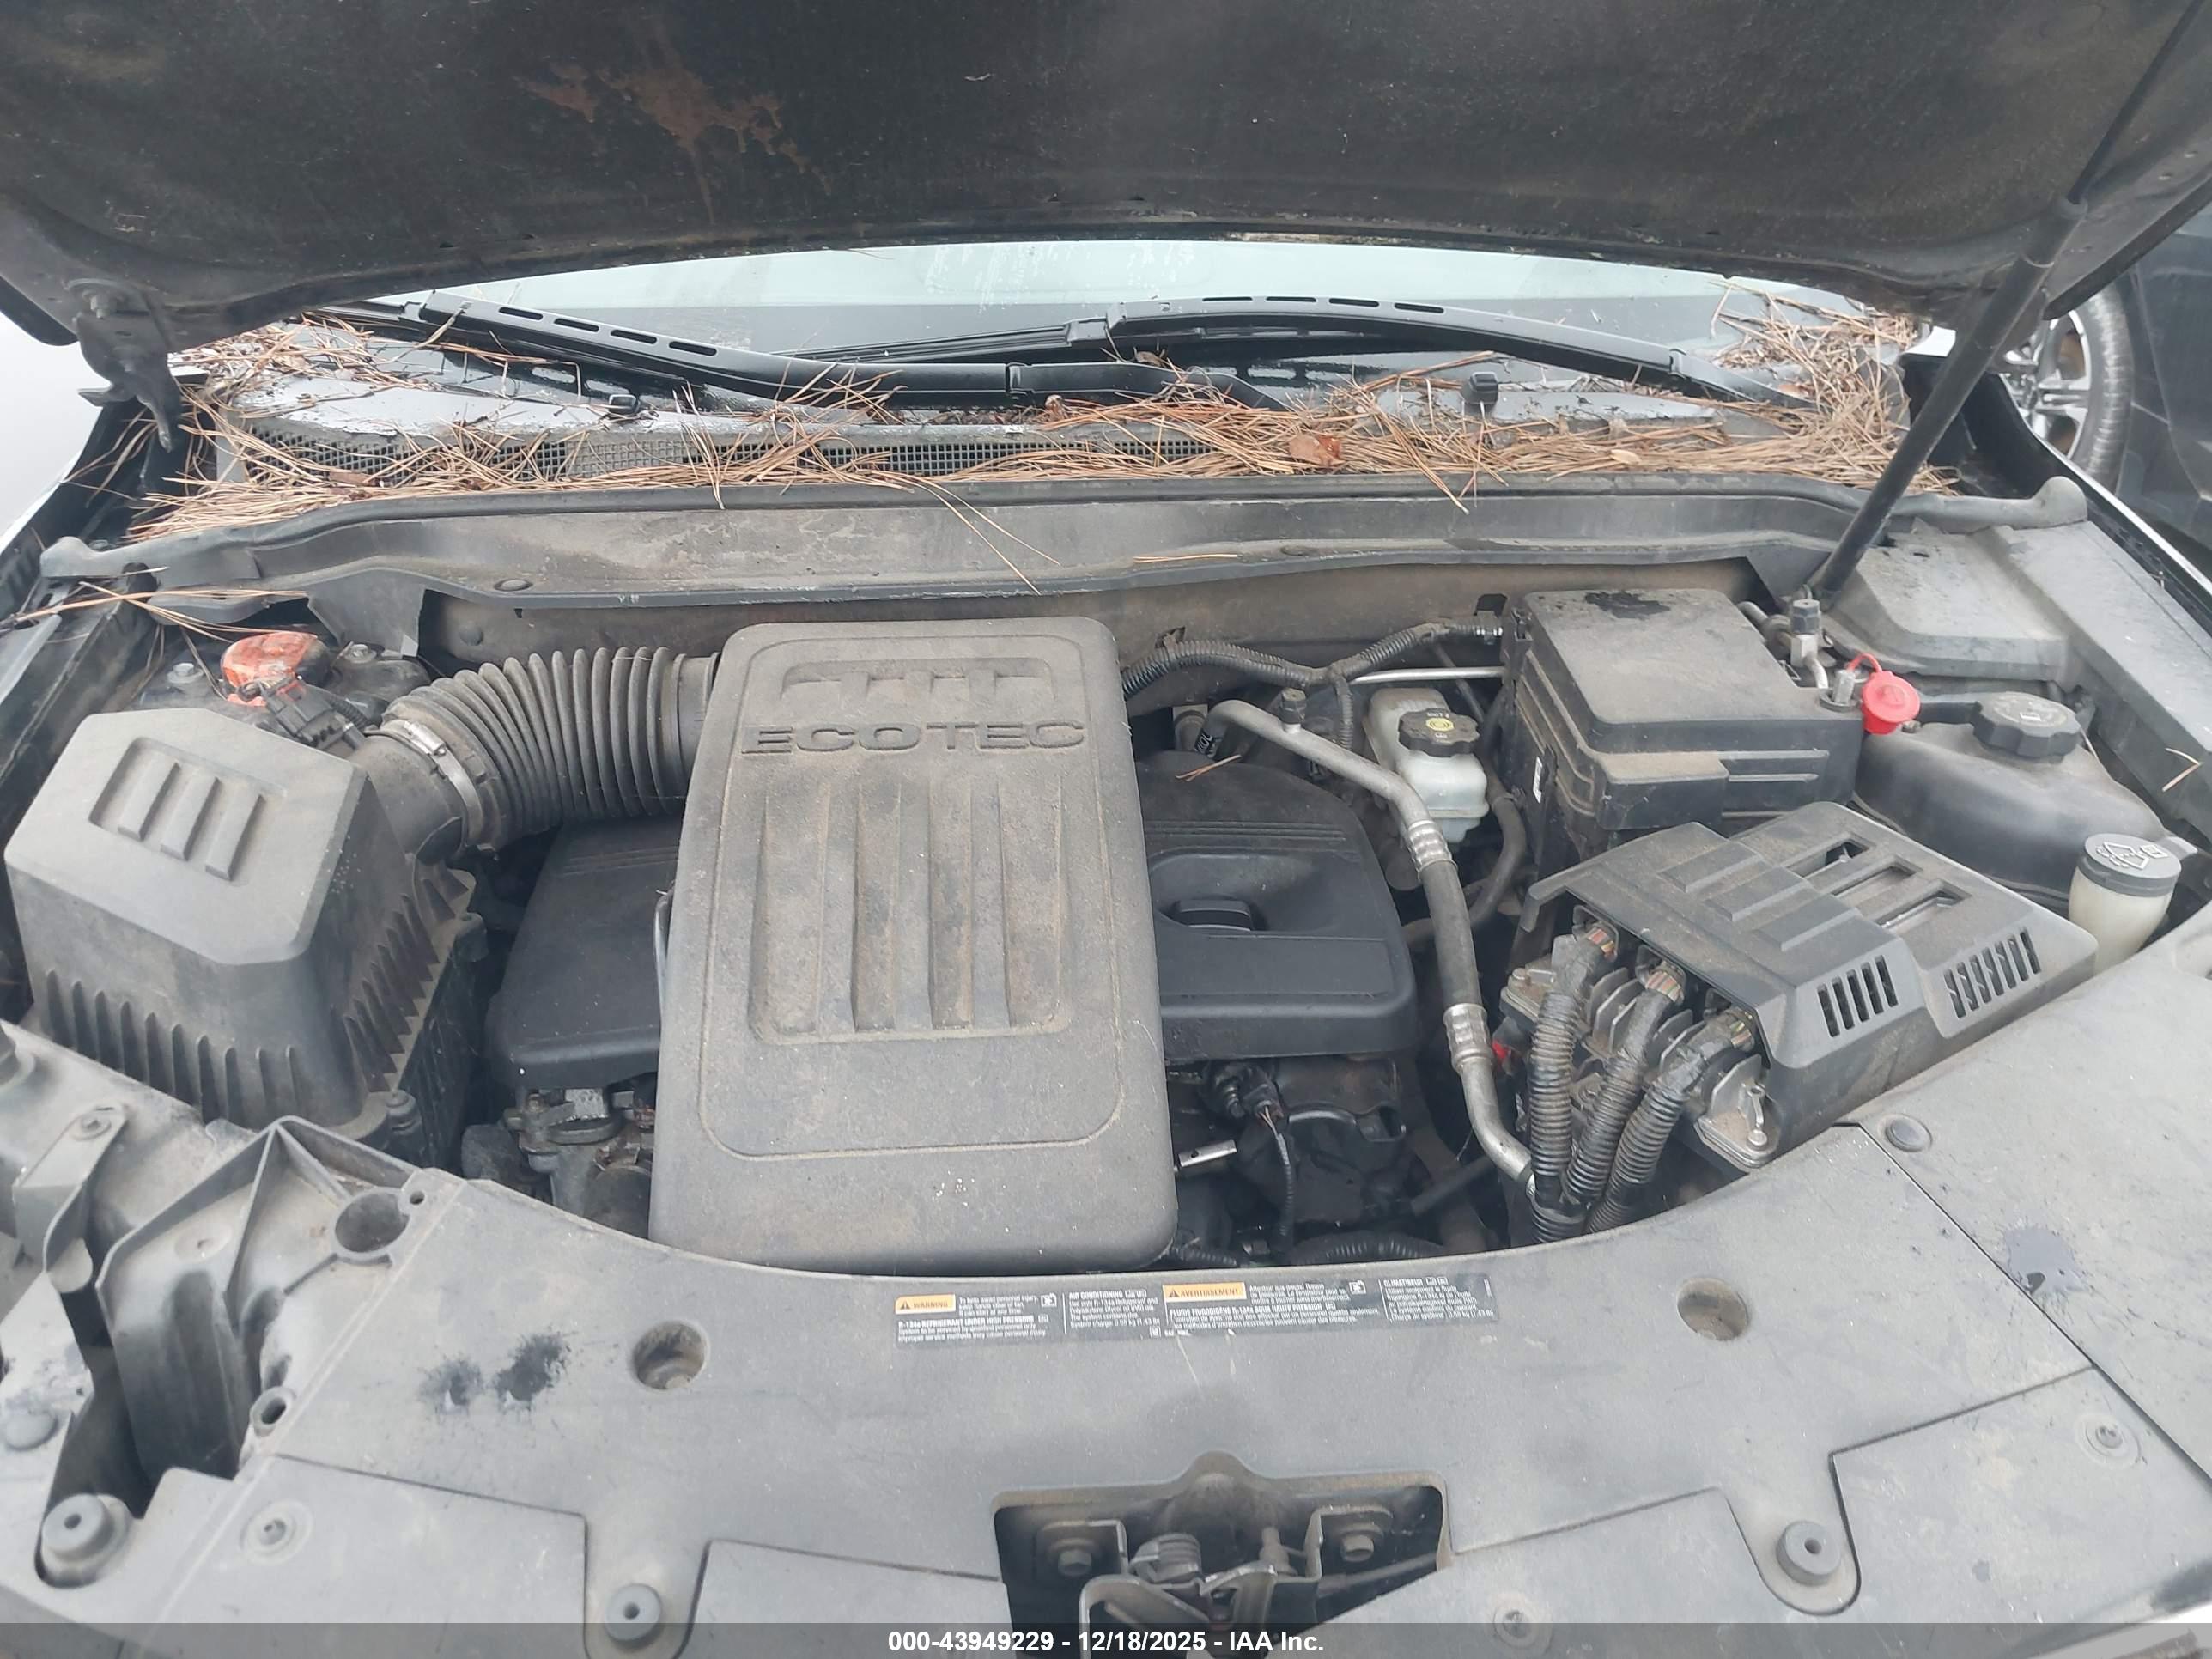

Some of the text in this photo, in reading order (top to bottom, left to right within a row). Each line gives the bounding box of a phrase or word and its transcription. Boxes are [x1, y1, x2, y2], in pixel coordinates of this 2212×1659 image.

[741, 720, 1085, 754] ECOTEC
[1080, 1291, 1123, 1299] CONDITIONING
[921, 1319, 963, 1328] REFRIGERANT
[964, 1317, 986, 1326] UNDER
[1003, 1316, 1034, 1324] PRESSURE
